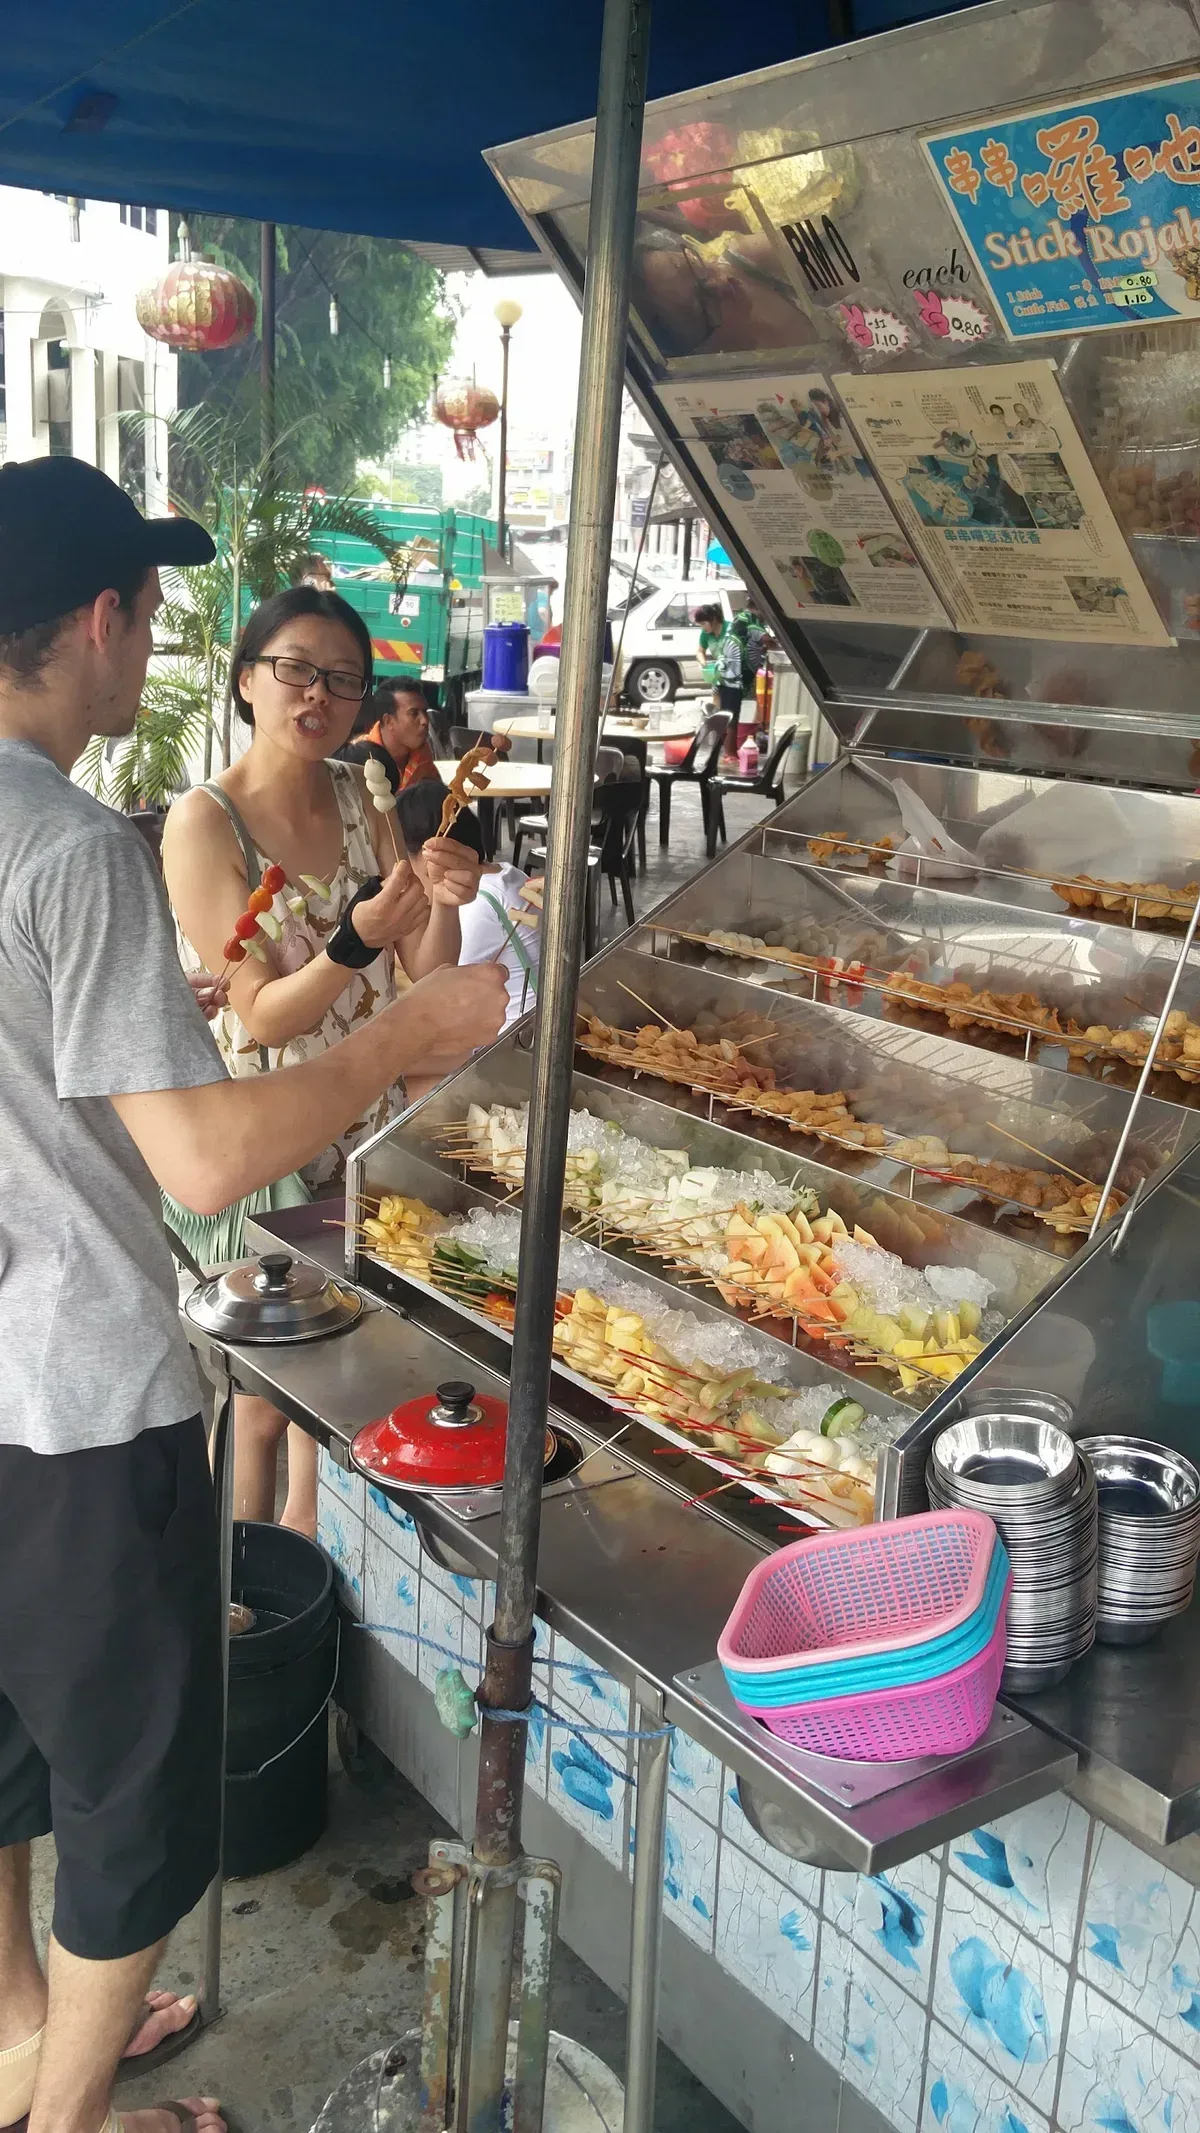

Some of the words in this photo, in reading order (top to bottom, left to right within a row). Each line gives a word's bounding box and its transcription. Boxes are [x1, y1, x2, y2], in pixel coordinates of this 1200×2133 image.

[984, 218, 1083, 271] Stick
[1084, 204, 1200, 268] Rojak
[780, 218, 844, 292] RM
[902, 248, 972, 289] each
[1126, 274, 1152, 287] 0.80
[1015, 287, 1044, 302] Stick
[1124, 294, 1148, 306] 1.10
[1013, 303, 1046, 317] Cuttle
[1045, 297, 1070, 312] Fish
[951, 317, 982, 336] 0.80
[874, 332, 899, 347] 1.10
